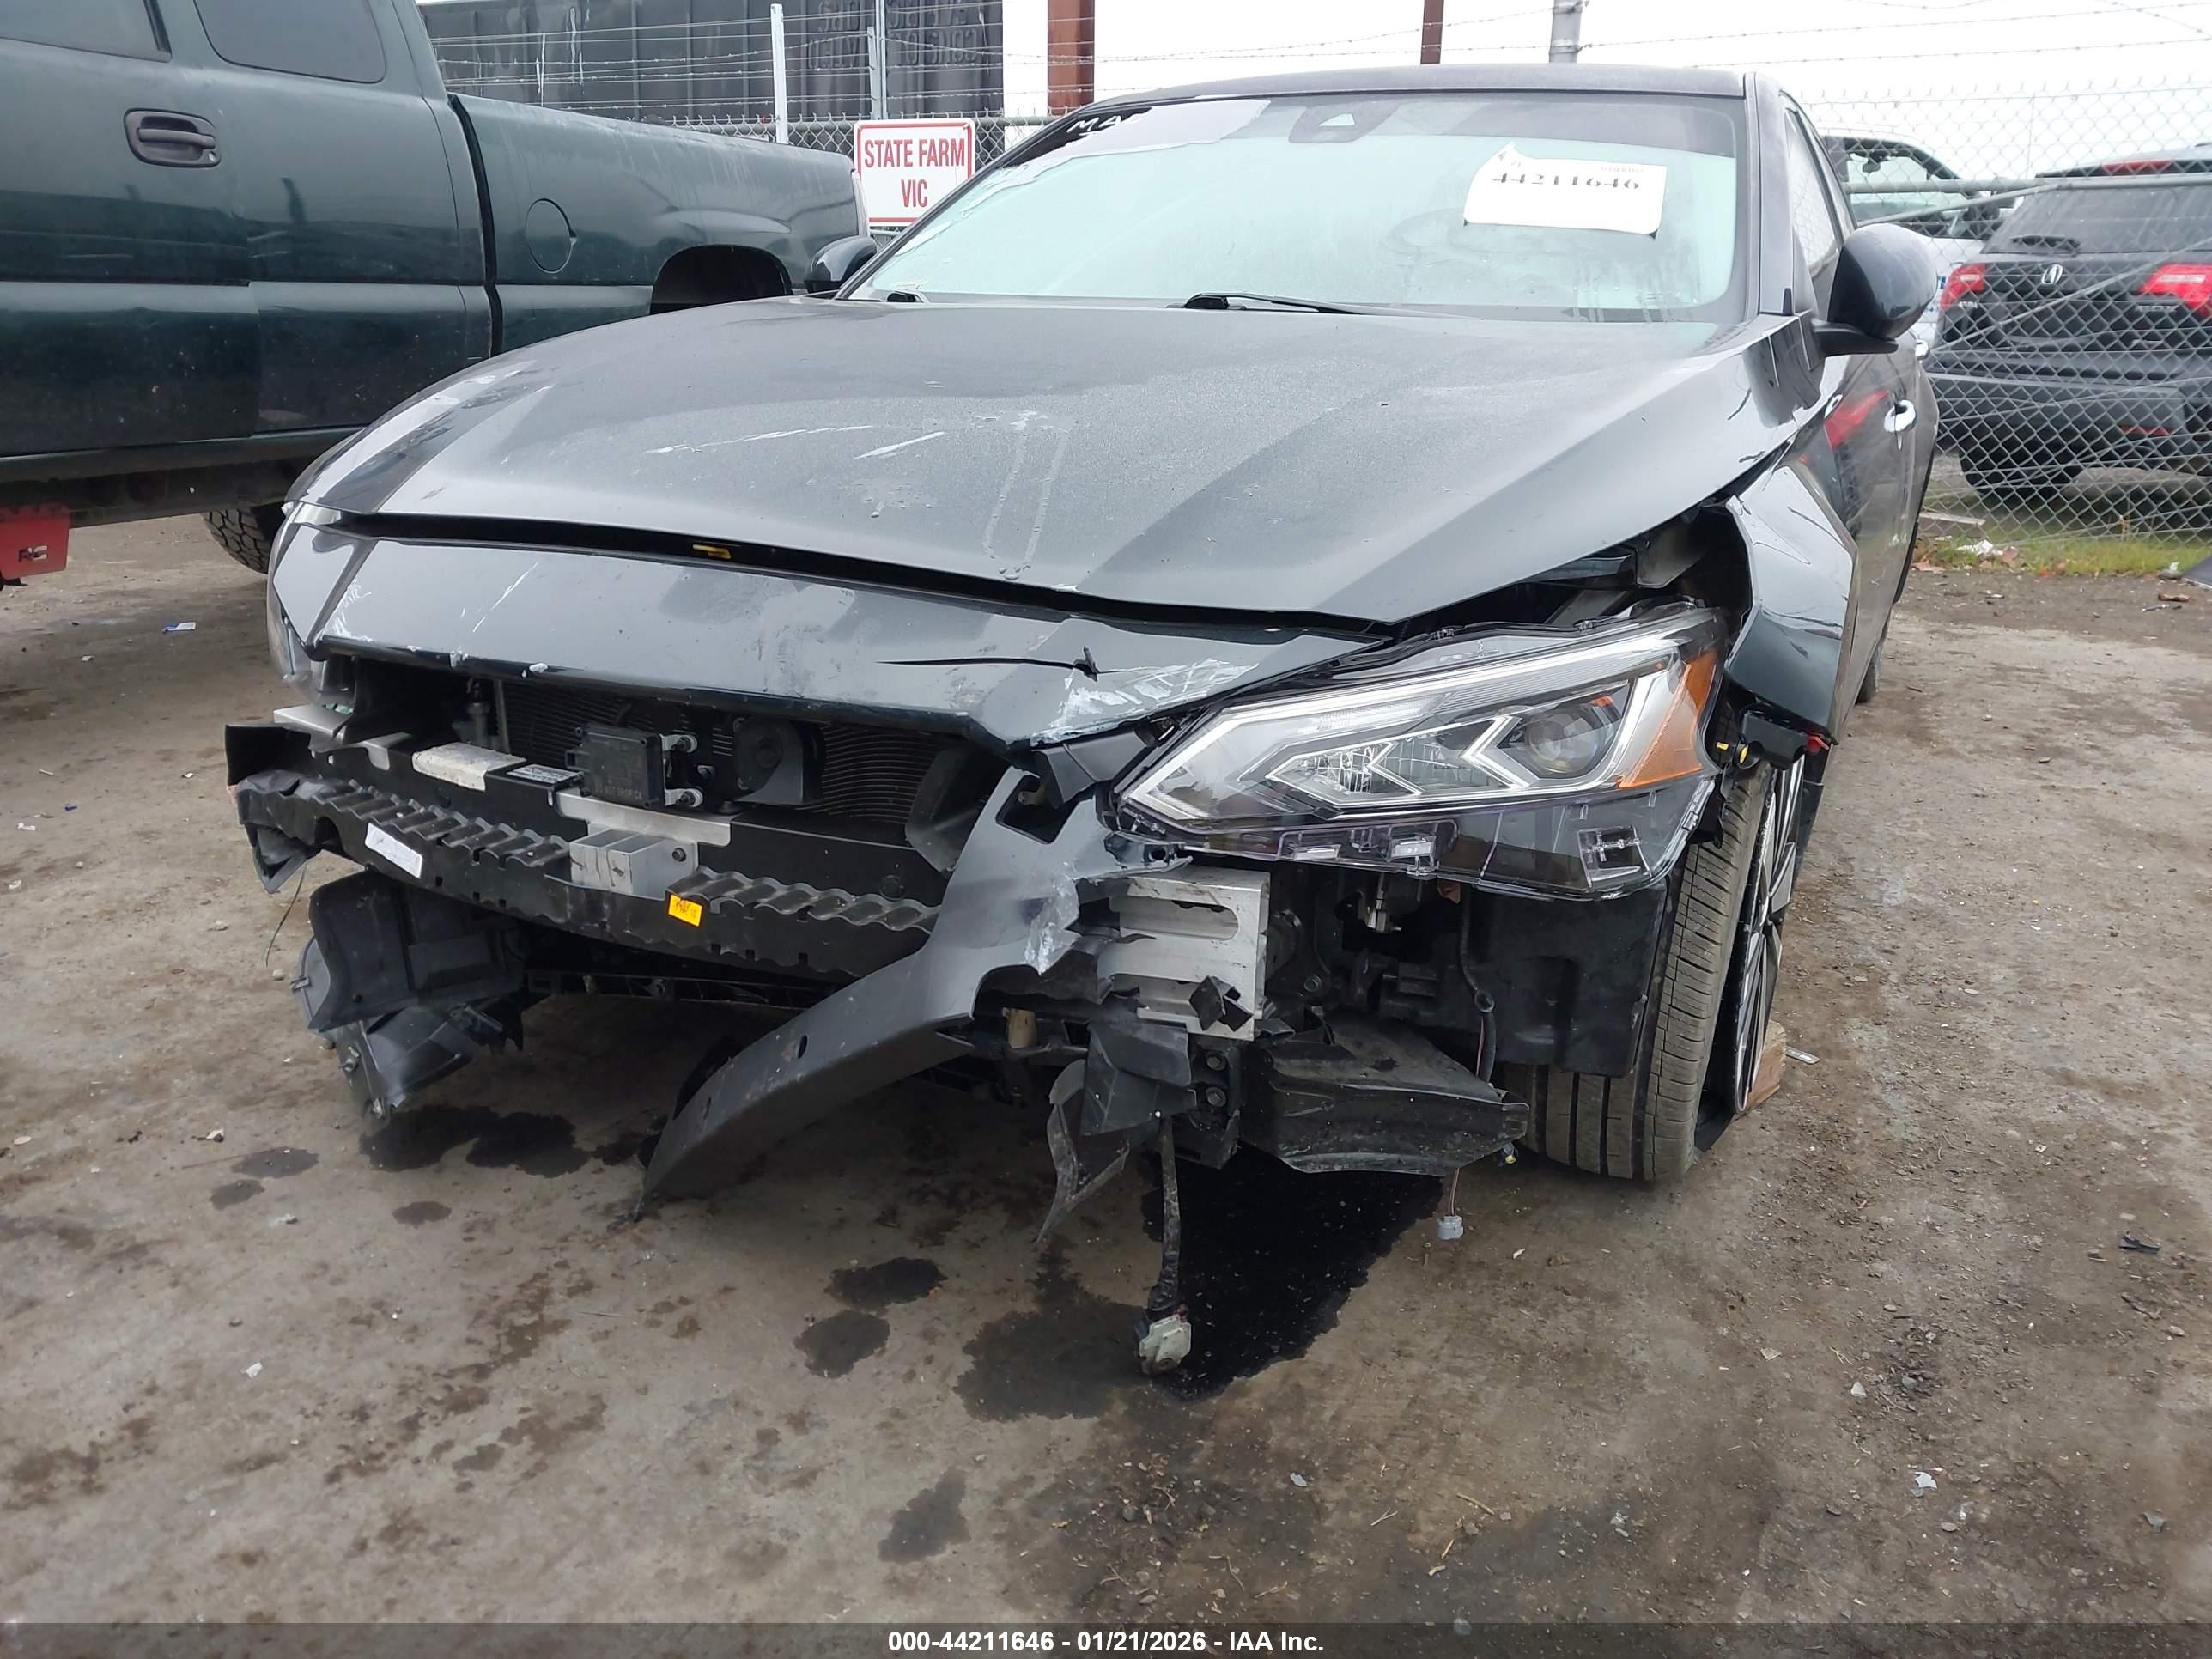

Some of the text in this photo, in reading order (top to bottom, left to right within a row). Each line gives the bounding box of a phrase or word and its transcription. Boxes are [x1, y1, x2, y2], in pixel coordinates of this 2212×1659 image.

[864, 138, 965, 168] STATE FARM
[901, 179, 928, 207] VIC
